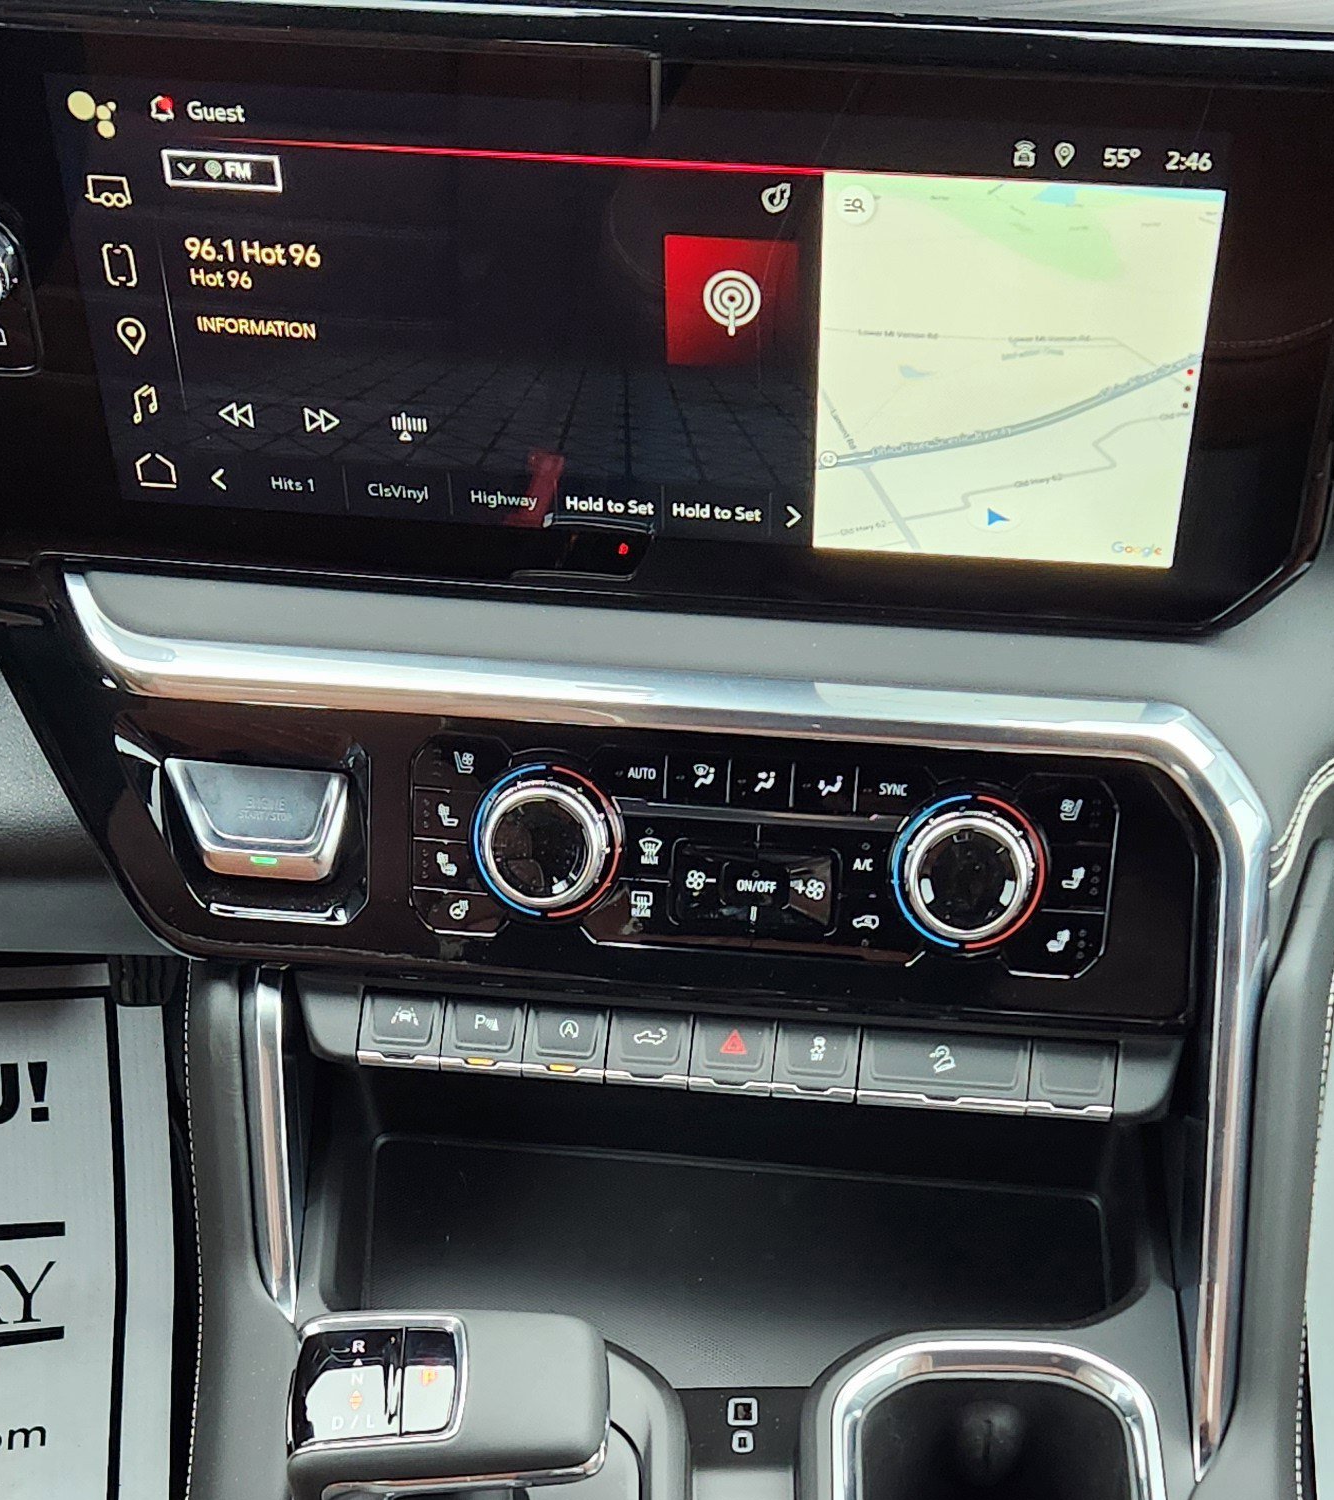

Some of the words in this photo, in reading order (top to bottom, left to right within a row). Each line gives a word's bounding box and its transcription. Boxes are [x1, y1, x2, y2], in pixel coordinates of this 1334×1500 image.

[186, 100, 246, 123] Guest
[224, 161, 252, 181] FM
[1165, 150, 1214, 172] 2:46
[184, 236, 235, 263] 96.1
[241, 240, 287, 266] Hot
[288, 243, 321, 268] 96
[189, 267, 225, 287] Hot
[226, 269, 253, 290] 96
[196, 315, 317, 341] INFORMATION
[270, 475, 303, 492] Hits
[307, 478, 315, 492] 1
[367, 483, 430, 503] ClsVinyl
[470, 490, 538, 511] Highway
[565, 496, 604, 513] Hold
[606, 498, 625, 514] to
[627, 500, 655, 516] Set
[672, 502, 711, 519] Hold
[713, 504, 732, 520] to
[734, 506, 763, 523] Set
[1111, 541, 1163, 557] Google
[627, 767, 657, 780] AUTO
[878, 783, 908, 797] SYNC
[852, 858, 874, 872] A/C
[736, 878, 778, 894] ON/OFF
[351, 1339, 366, 1354] R
[351, 1372, 364, 1386] N
